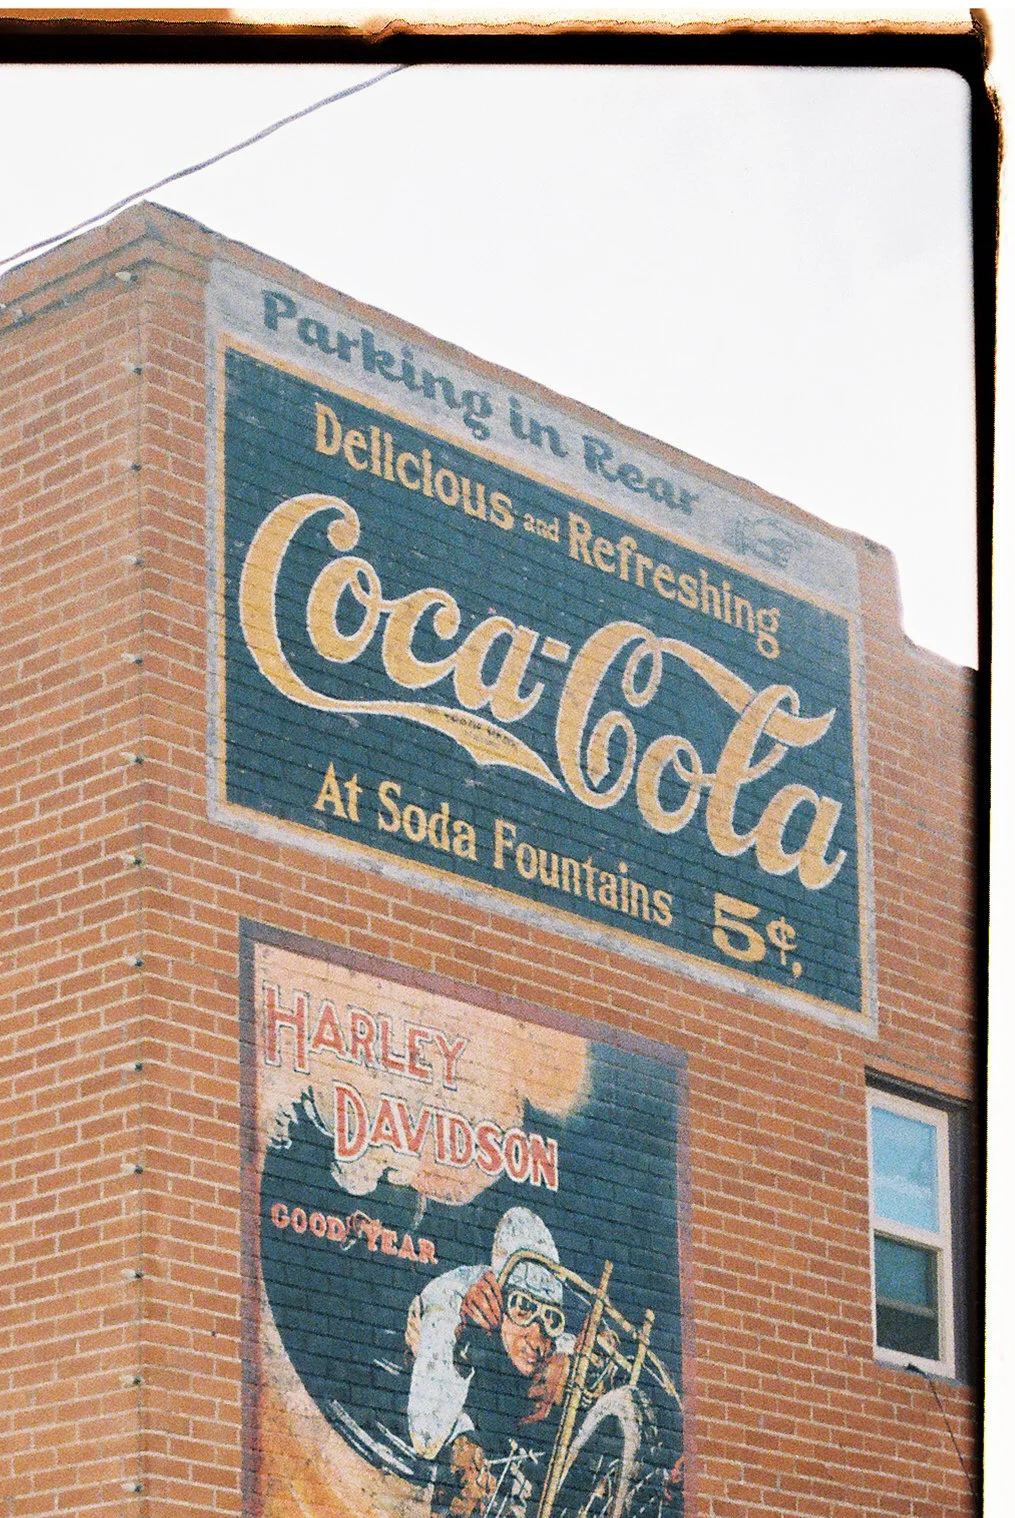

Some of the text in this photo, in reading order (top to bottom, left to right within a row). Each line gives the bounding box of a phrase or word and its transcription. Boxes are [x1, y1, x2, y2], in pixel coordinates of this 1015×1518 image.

[262, 289, 701, 516] Parking in Rear
[313, 401, 781, 659] Delicious and Refreshing
[239, 493, 848, 891] Coca-Cola
[313, 762, 365, 821] At
[377, 780, 477, 862] Soda
[492, 818, 674, 929] Fountains
[262, 980, 470, 1090] HARLEY
[333, 1079, 559, 1192] DAVIDSON
